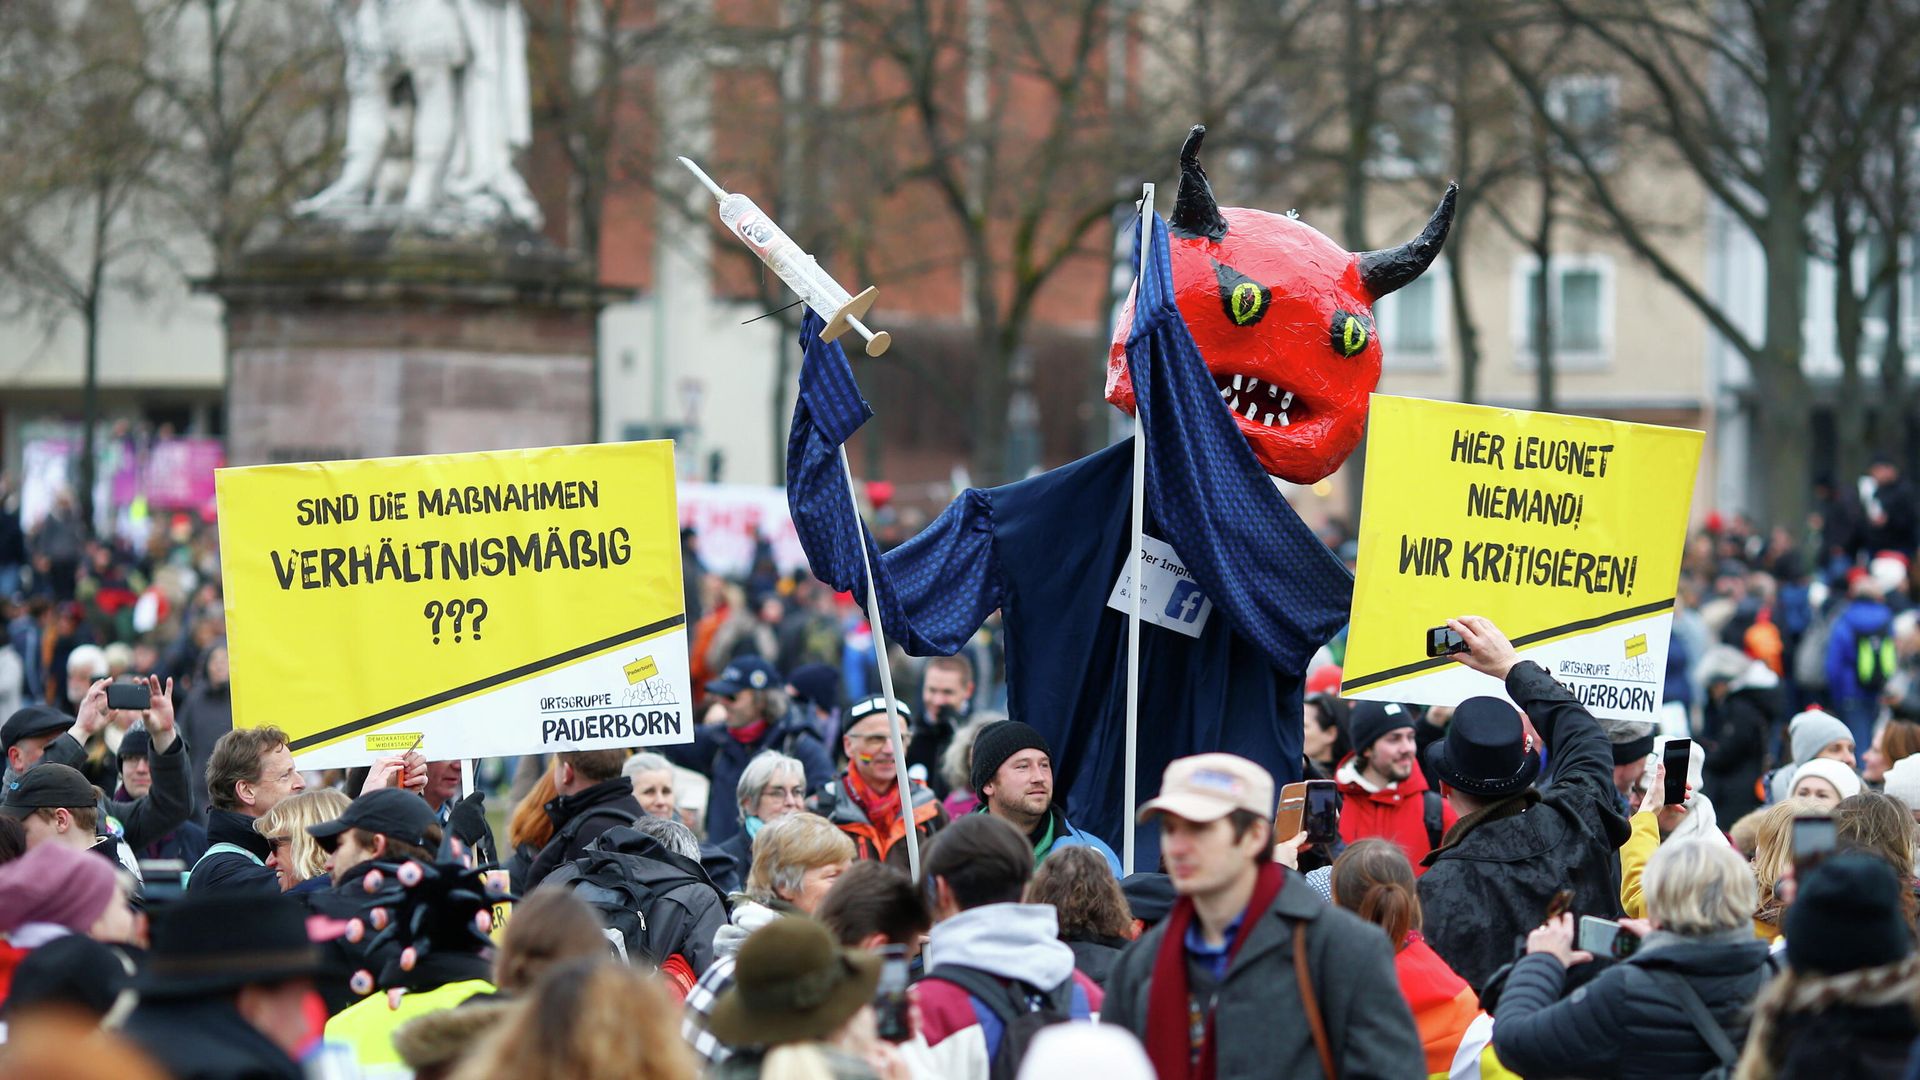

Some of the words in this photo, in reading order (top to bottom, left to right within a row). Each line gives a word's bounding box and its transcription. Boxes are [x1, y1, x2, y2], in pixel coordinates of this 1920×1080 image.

[1450, 429, 1504, 470] HIER
[1514, 436, 1614, 478] LEUGNET
[297, 493, 358, 526] SIND
[370, 491, 408, 522] DIE
[418, 480, 599, 519] MAßNAHMEN
[1467, 483, 1584, 531] NIEMAND!
[271, 526, 631, 590] VERHÄLTNISMÄßIG
[1399, 534, 1452, 578] WIR
[1461, 540, 1638, 598] KRITISIEREN!
[424, 598, 488, 645] ???
[1560, 660, 1610, 676] ORTSGRUPPE
[540, 693, 612, 710] ORTSGRUPPE
[542, 711, 681, 744] PADERBORN
